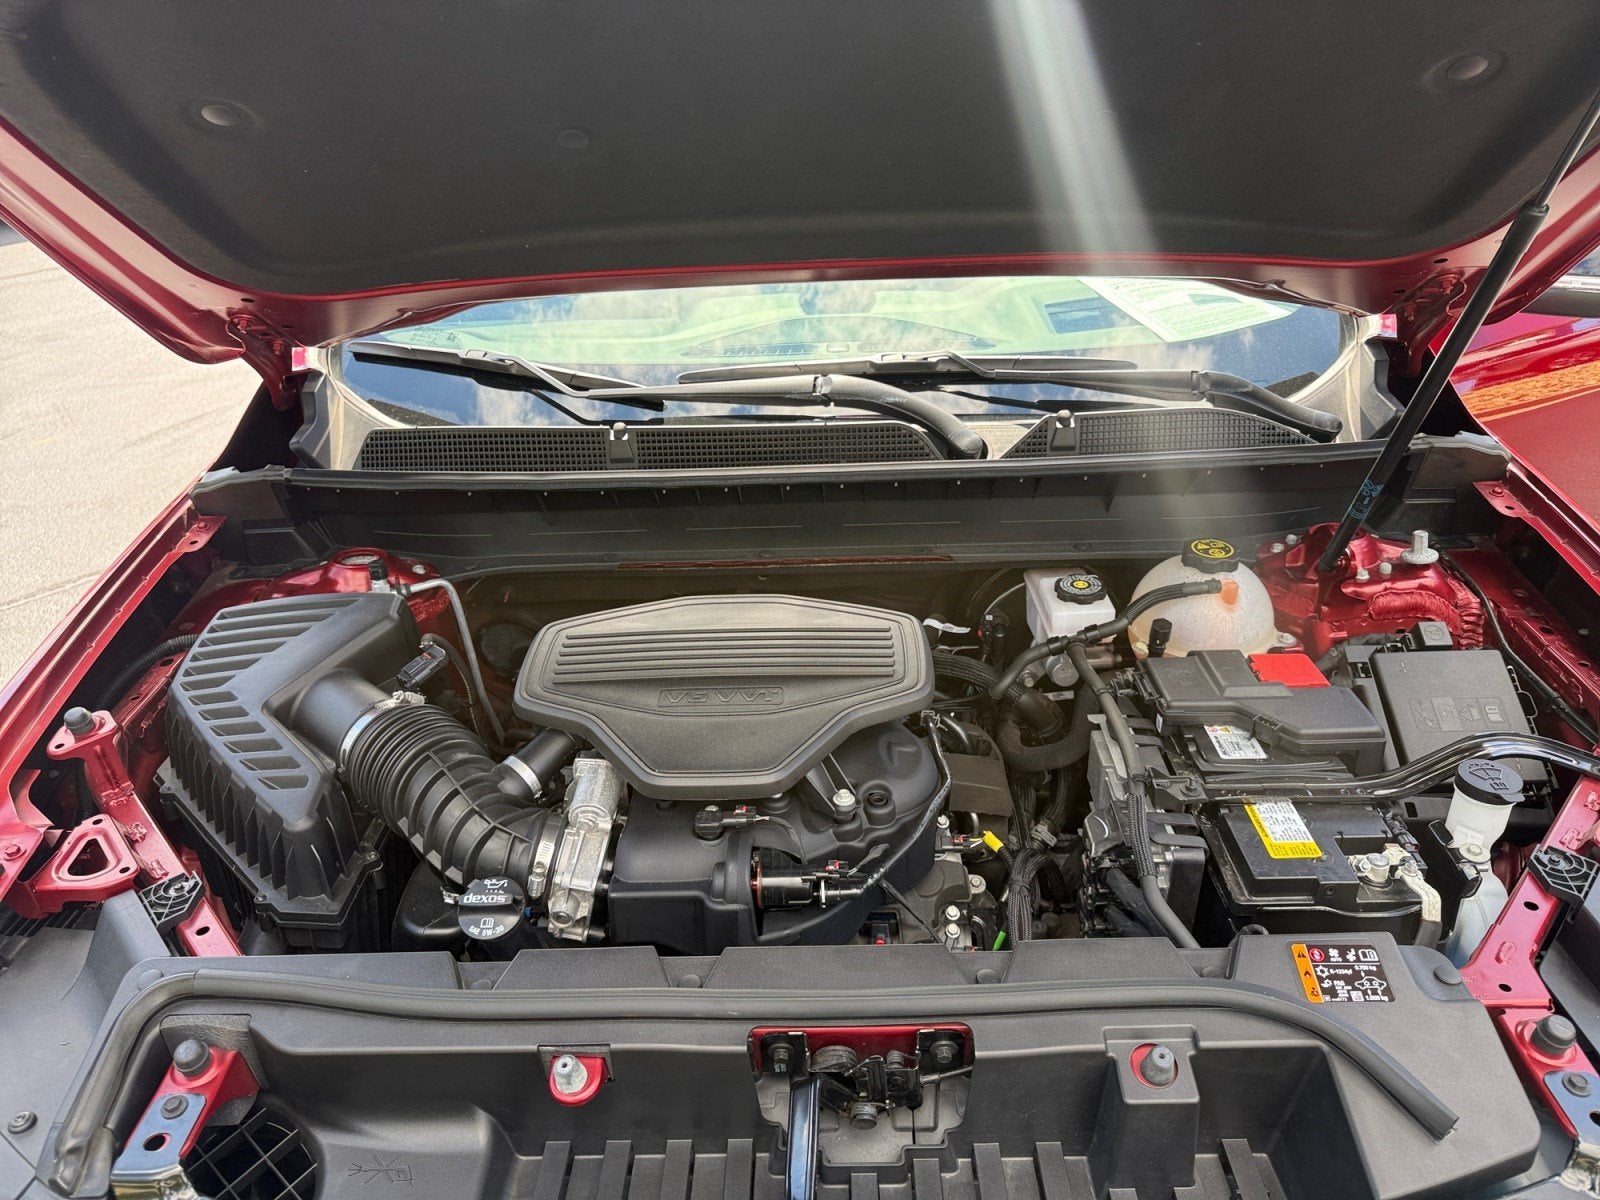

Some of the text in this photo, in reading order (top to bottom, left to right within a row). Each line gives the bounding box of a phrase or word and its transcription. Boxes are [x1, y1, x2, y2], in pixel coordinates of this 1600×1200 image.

[714, 690, 779, 702] VVT
[463, 893, 507, 903] dexos
[468, 925, 504, 936] SAE 5W-30
